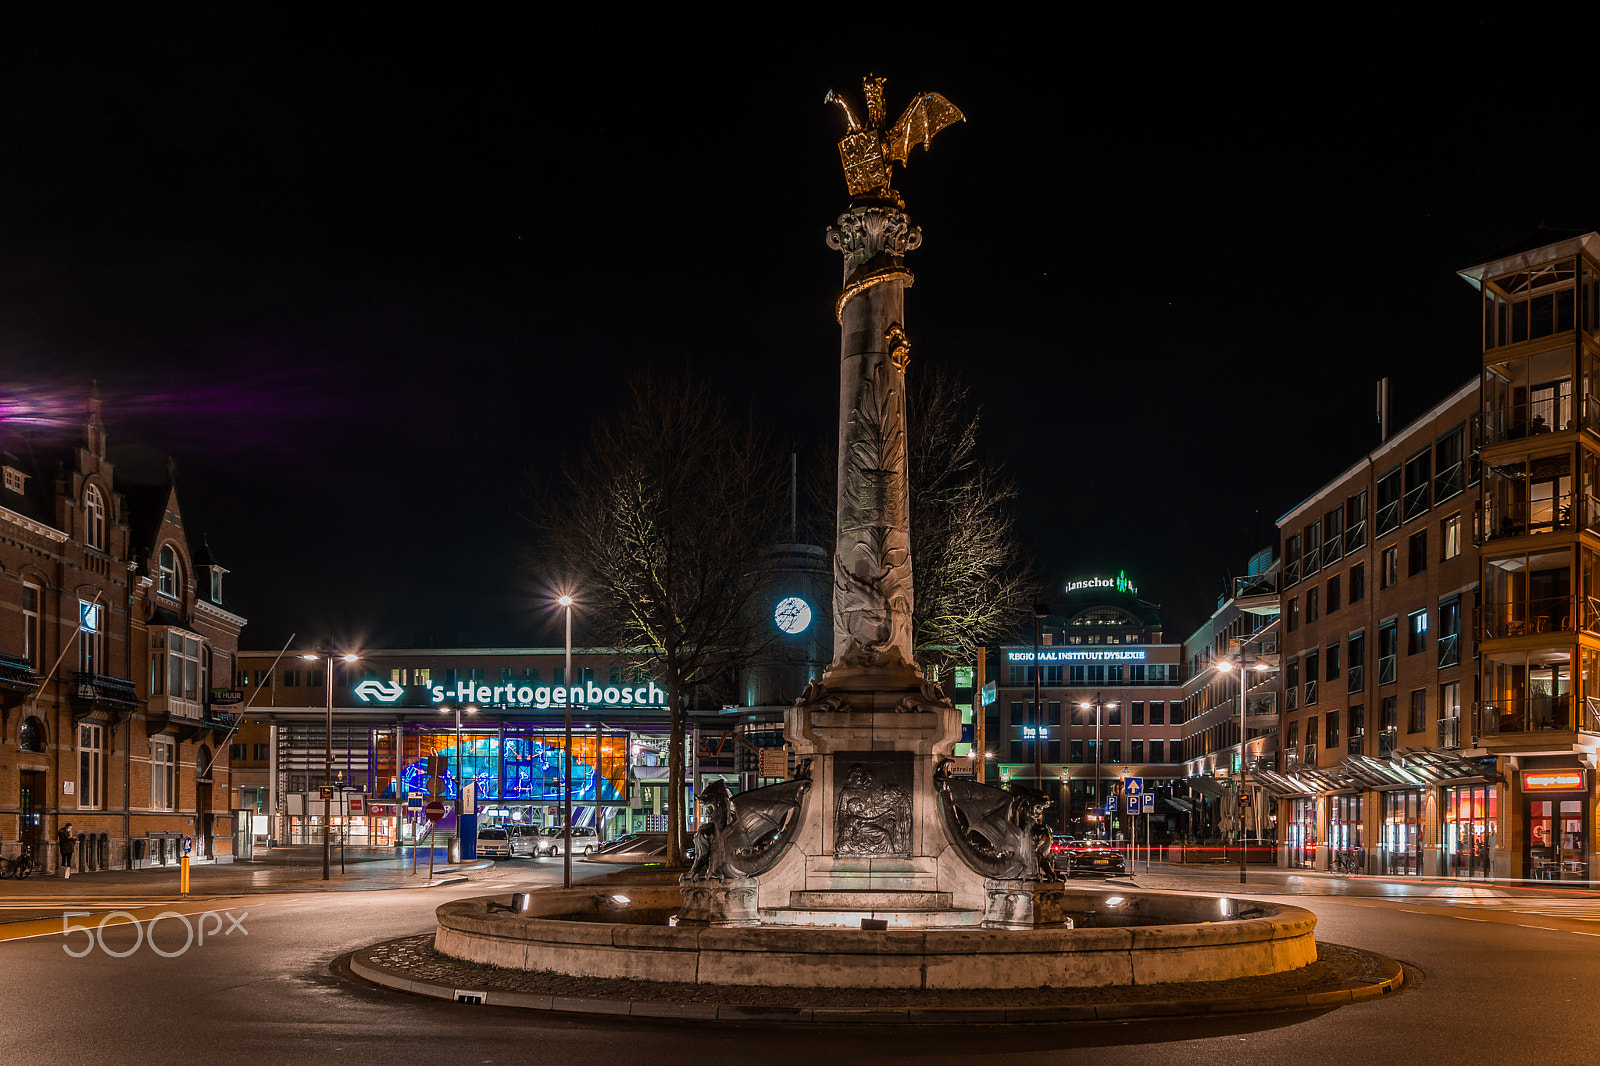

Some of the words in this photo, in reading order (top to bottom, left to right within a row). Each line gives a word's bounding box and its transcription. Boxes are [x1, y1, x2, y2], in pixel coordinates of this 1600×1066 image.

[1058, 651, 1104, 661] INSTITUUT
[1104, 651, 1146, 660] DYSLEXIE
[426, 680, 664, 709] 's-Hertogenbosch
[1109, 797, 1115, 805] P
[1130, 797, 1137, 807] P
[1145, 796, 1152, 804] P
